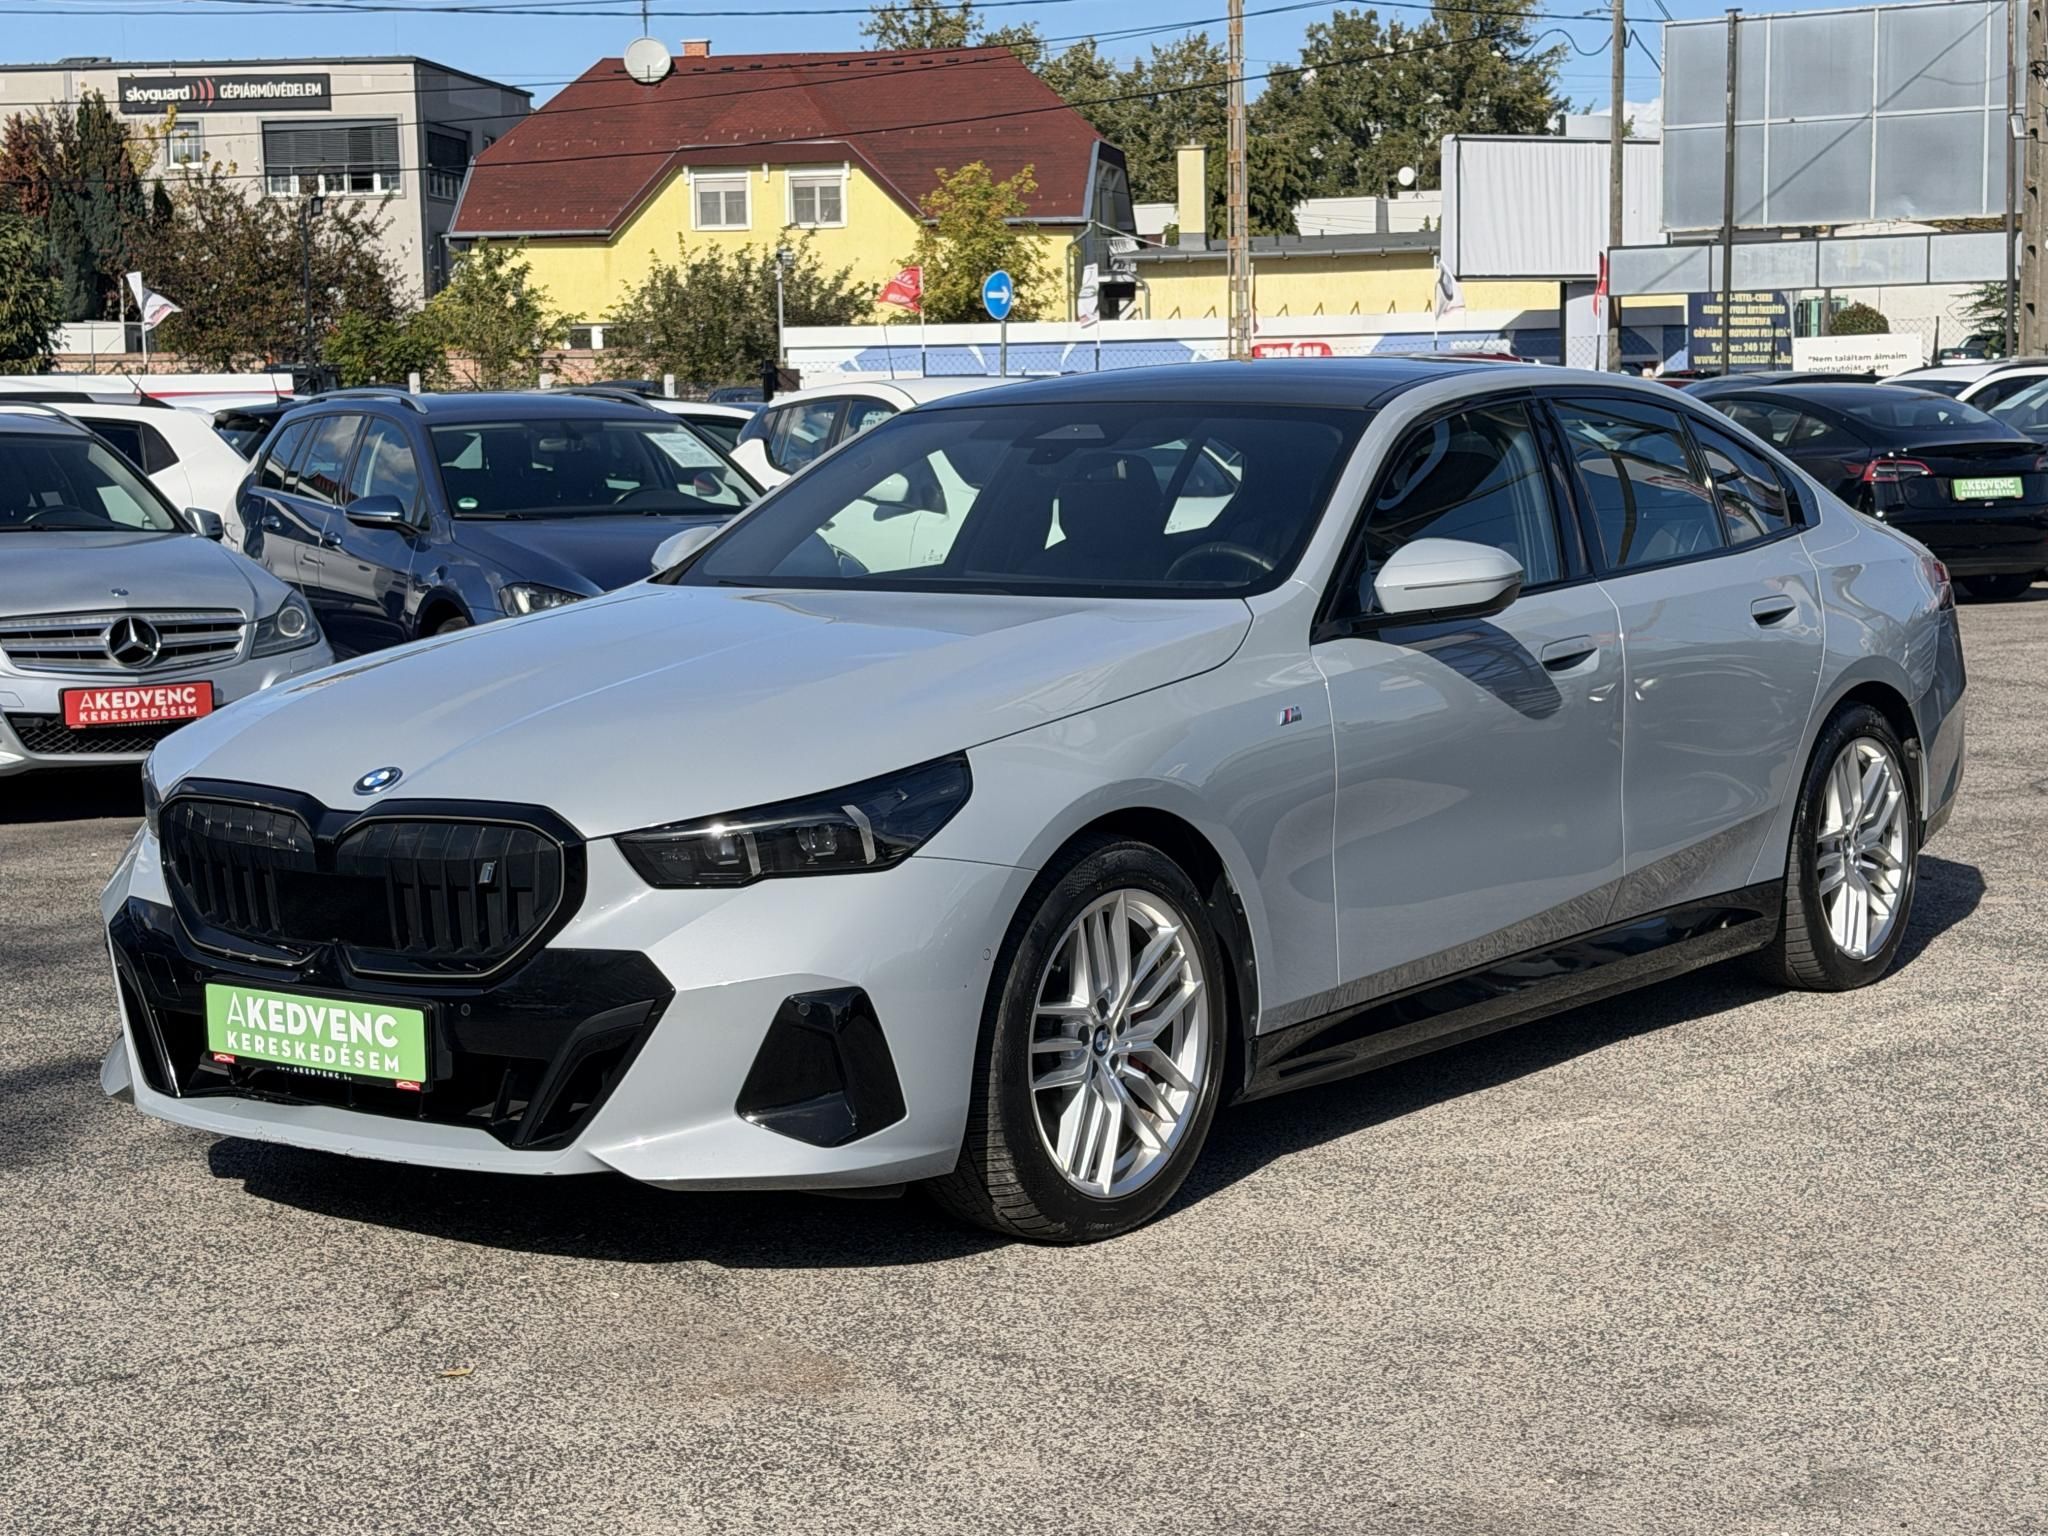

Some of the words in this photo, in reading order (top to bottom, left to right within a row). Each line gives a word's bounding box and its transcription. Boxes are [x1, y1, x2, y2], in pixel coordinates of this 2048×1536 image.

[125, 85, 190, 104] skyguard
[79, 705, 198, 722] KERESKEDÉSEM
[226, 1031, 400, 1073] KERESKEDÉSEM
